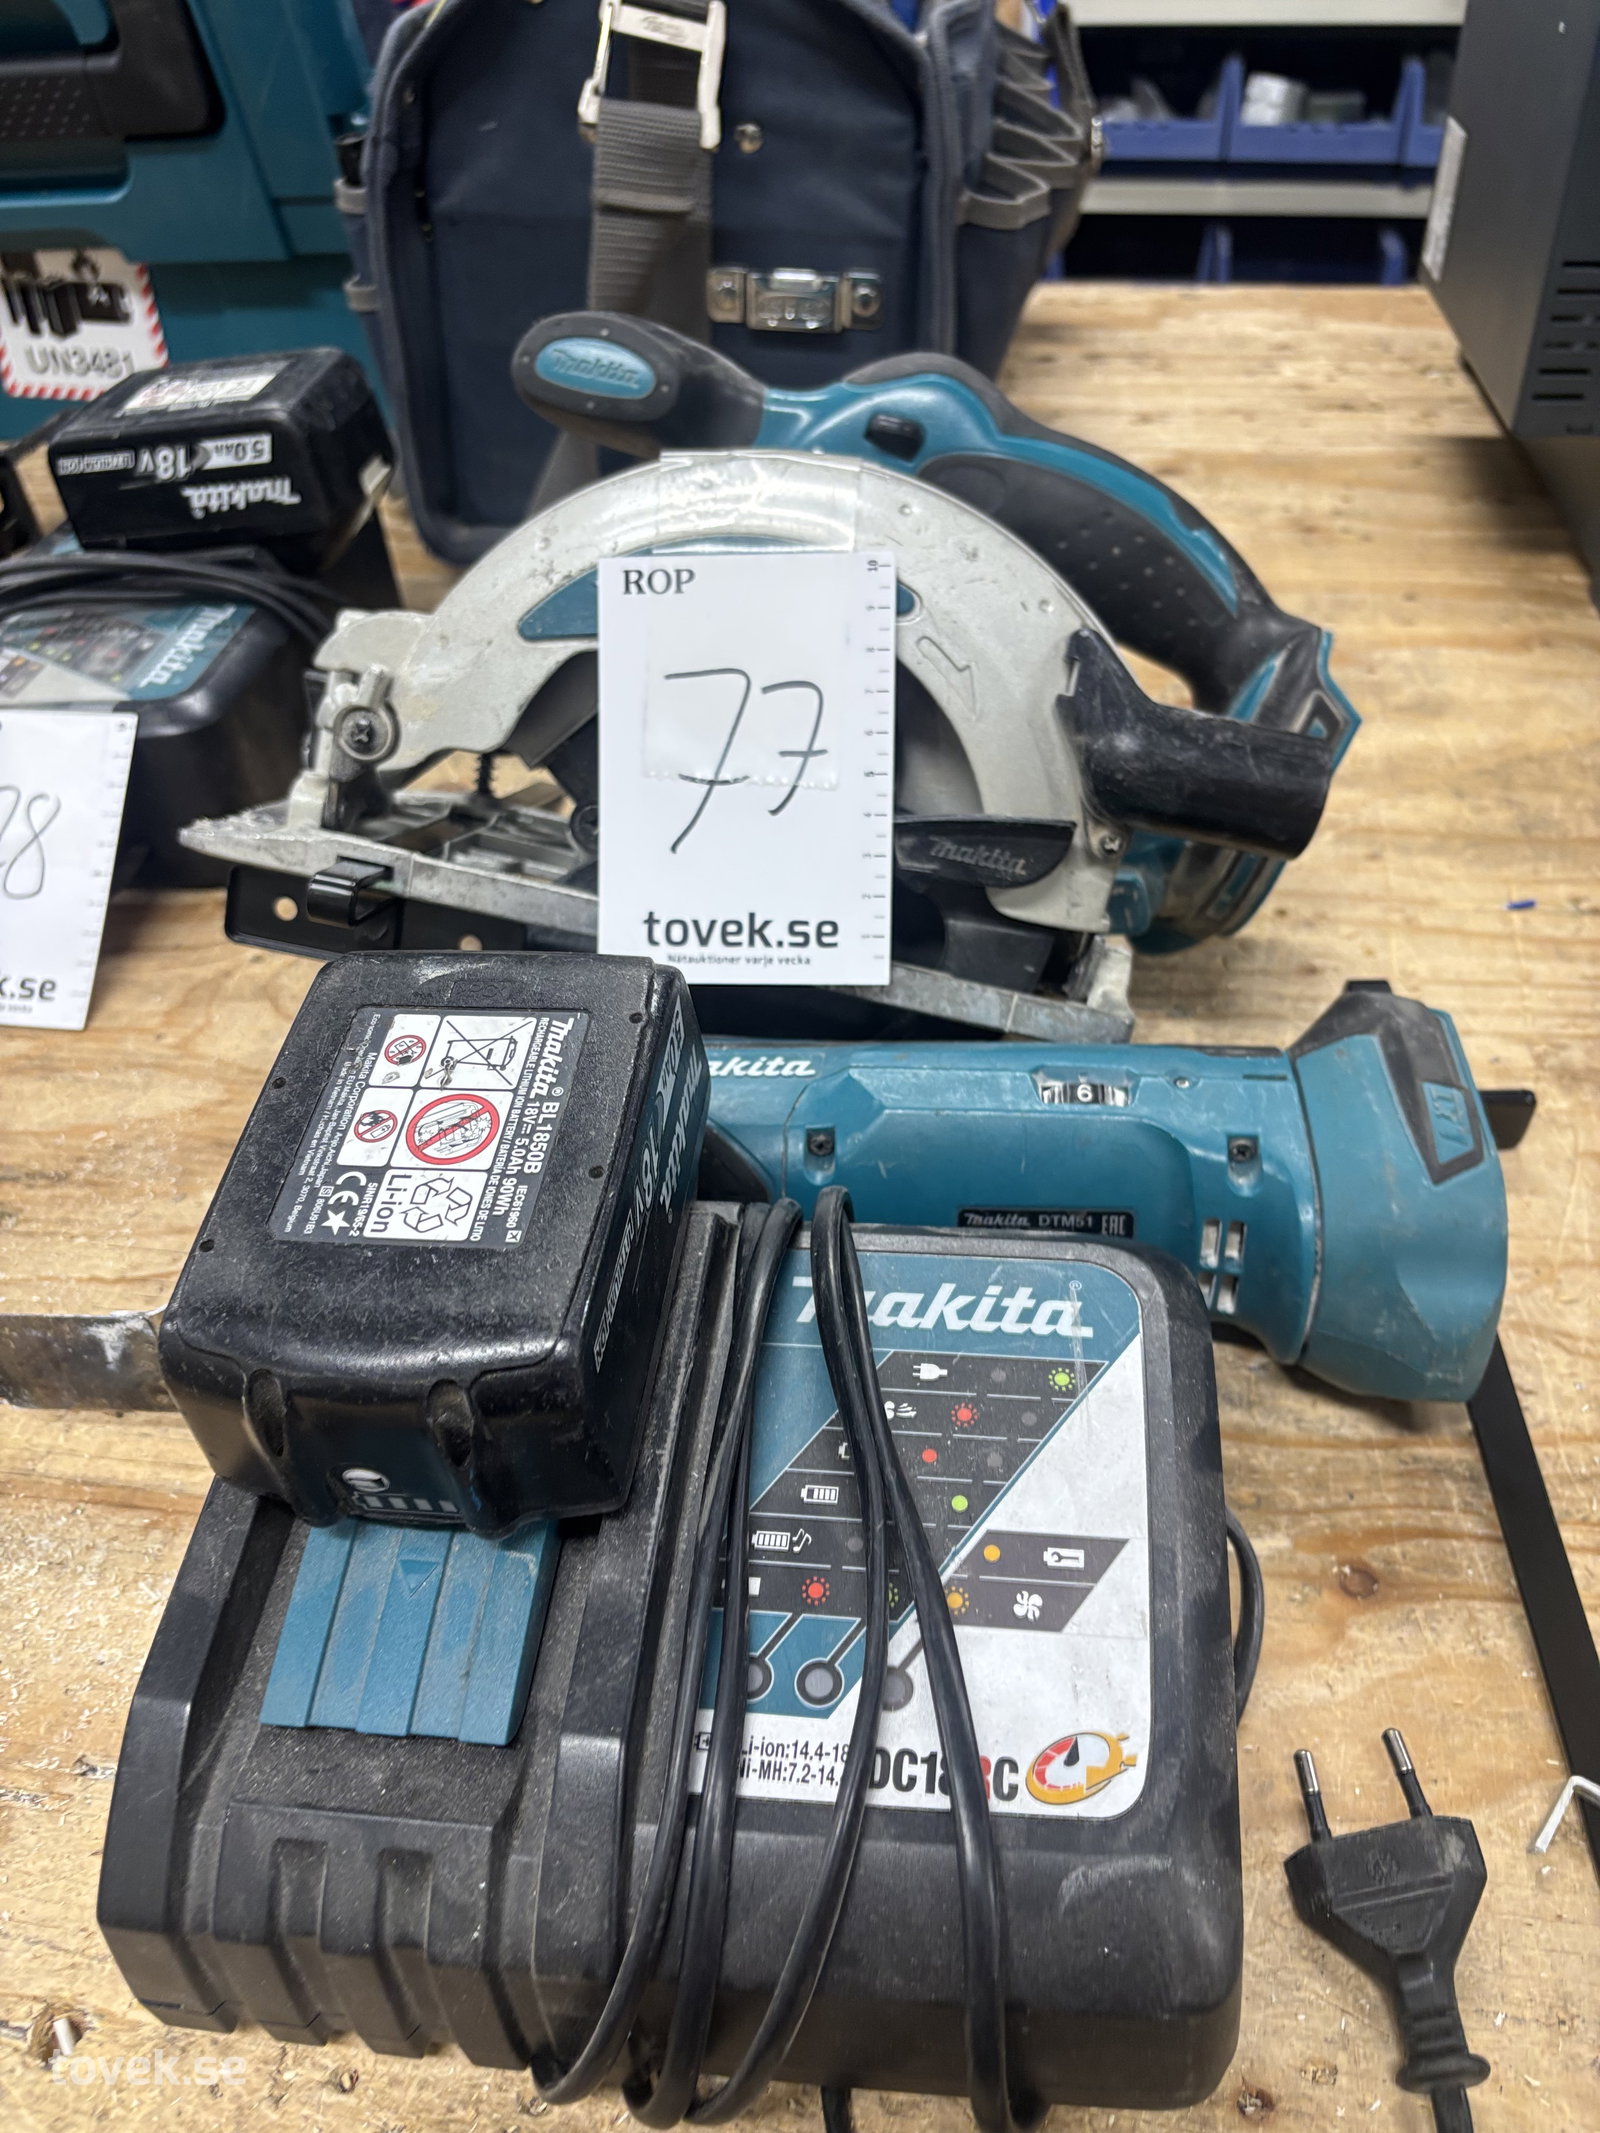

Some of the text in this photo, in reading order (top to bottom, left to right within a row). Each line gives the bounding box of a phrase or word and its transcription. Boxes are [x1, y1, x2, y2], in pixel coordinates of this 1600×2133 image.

[867, 559, 878, 572] 10
[623, 568, 696, 596] ROP
[664, 667, 828, 854] 77
[643, 910, 839, 948] tovek.se
[744, 955, 774, 968] varje
[777, 954, 811, 967] vecka
[526, 1017, 549, 1068] RECHARGEABLE
[359, 1052, 376, 1079] Makita
[518, 1069, 533, 1094] LITHIUM
[1077, 1084, 1093, 1103] 6
[338, 1081, 365, 1130] Corporation
[514, 1096, 524, 1107] ION
[310, 1139, 317, 1147] en
[298, 1148, 314, 1175] Vietnam
[493, 1100, 540, 1215] 18V 5.0Ah 90Wh
[506, 1101, 559, 1228] BL1850B IEC61960
[328, 1171, 367, 1206] CE
[489, 1174, 499, 1185] DE
[296, 1184, 309, 1203] 3070,
[371, 1173, 411, 1234] Li-ion
[481, 1185, 495, 1208] IONES
[283, 1204, 300, 1233] Belgium
[477, 1210, 488, 1220] DE
[1038, 1213, 1093, 1229] DTM51
